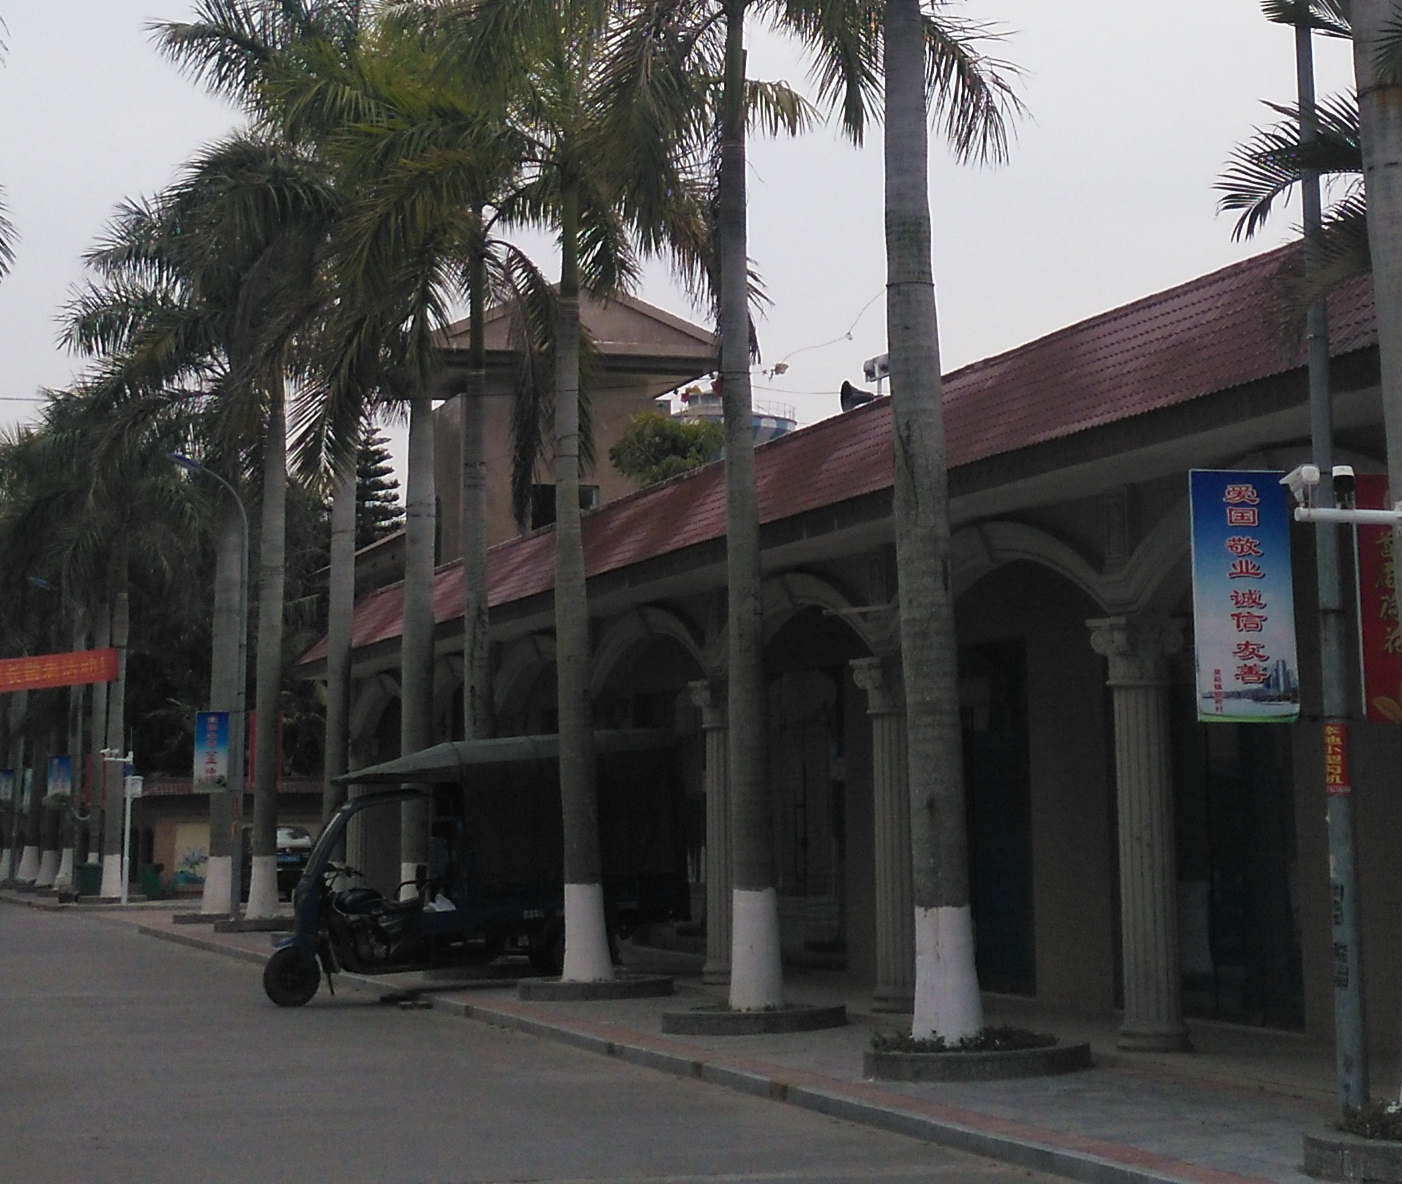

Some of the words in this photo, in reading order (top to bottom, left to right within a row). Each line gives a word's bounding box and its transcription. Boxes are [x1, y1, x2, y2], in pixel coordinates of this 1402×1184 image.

[1224, 484, 1270, 685] 爱国敬业诚信友善
